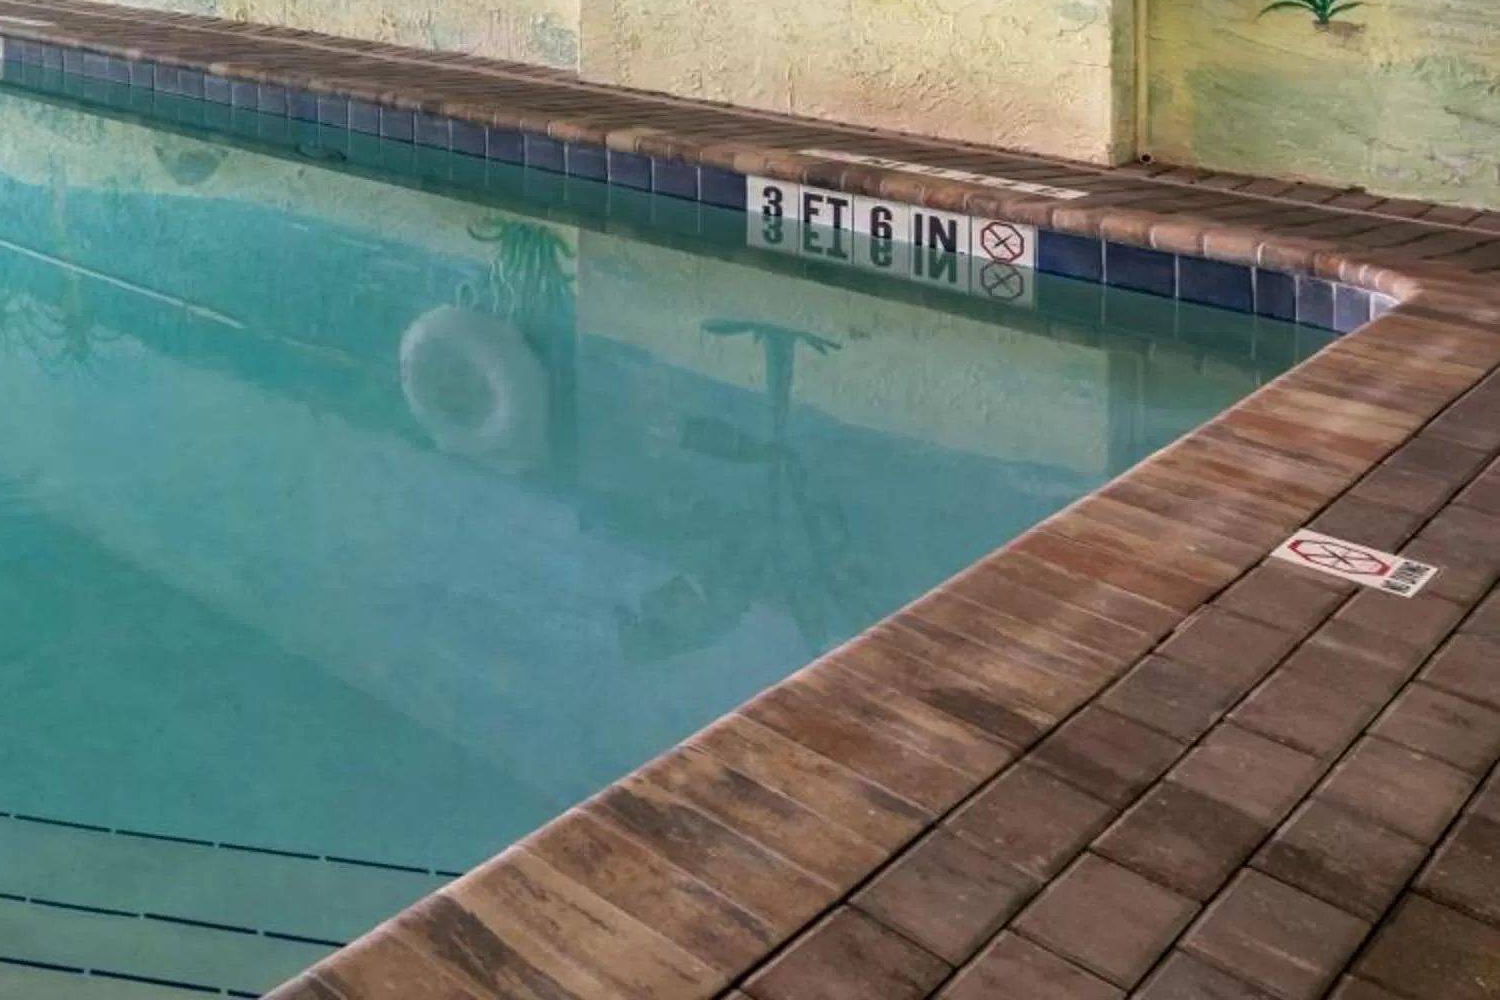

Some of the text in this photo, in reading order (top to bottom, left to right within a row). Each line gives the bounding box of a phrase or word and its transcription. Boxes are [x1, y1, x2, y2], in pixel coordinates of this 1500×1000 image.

[762, 186, 783, 217] 3
[803, 192, 848, 229] FT
[870, 205, 893, 239] 6
